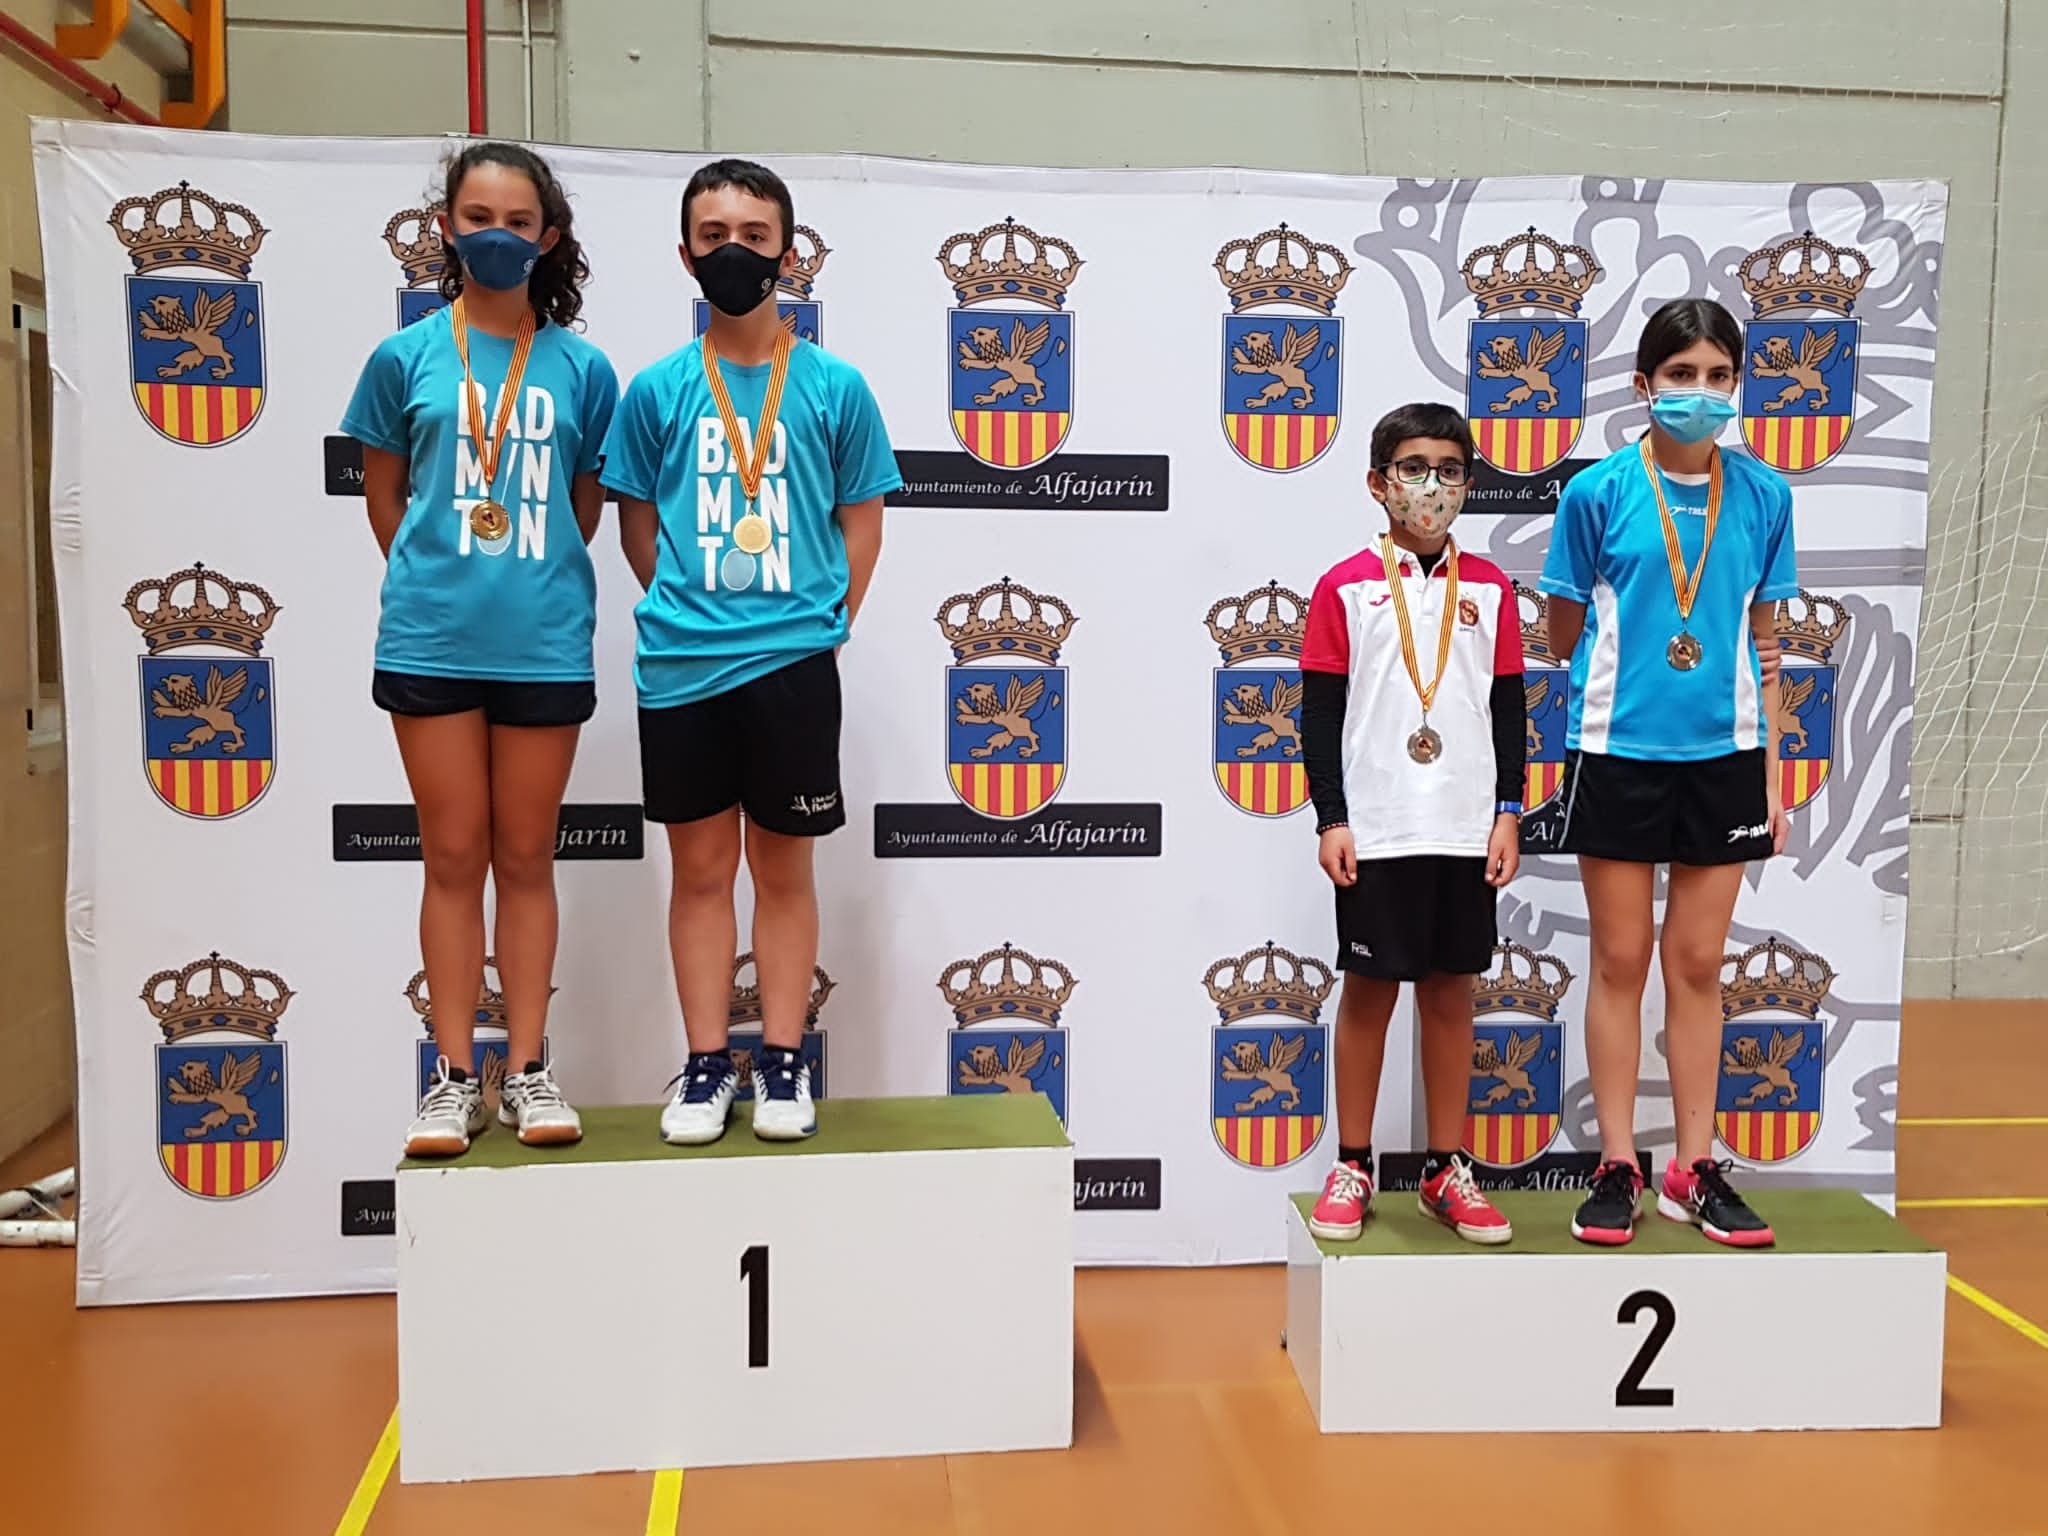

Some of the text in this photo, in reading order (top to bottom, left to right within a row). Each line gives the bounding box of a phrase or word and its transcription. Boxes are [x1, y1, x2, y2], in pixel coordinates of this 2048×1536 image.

[457, 381, 555, 441] BAD
[697, 416, 787, 475] BAD
[697, 476, 790, 534] MN
[899, 472, 1155, 503] yuntamiento de Alfajarín
[1516, 484, 1533, 499] de
[887, 820, 1148, 851] Ayuntamiento de Alfajarín
[740, 1245, 769, 1368] 1
[1616, 1289, 1676, 1407] 2
